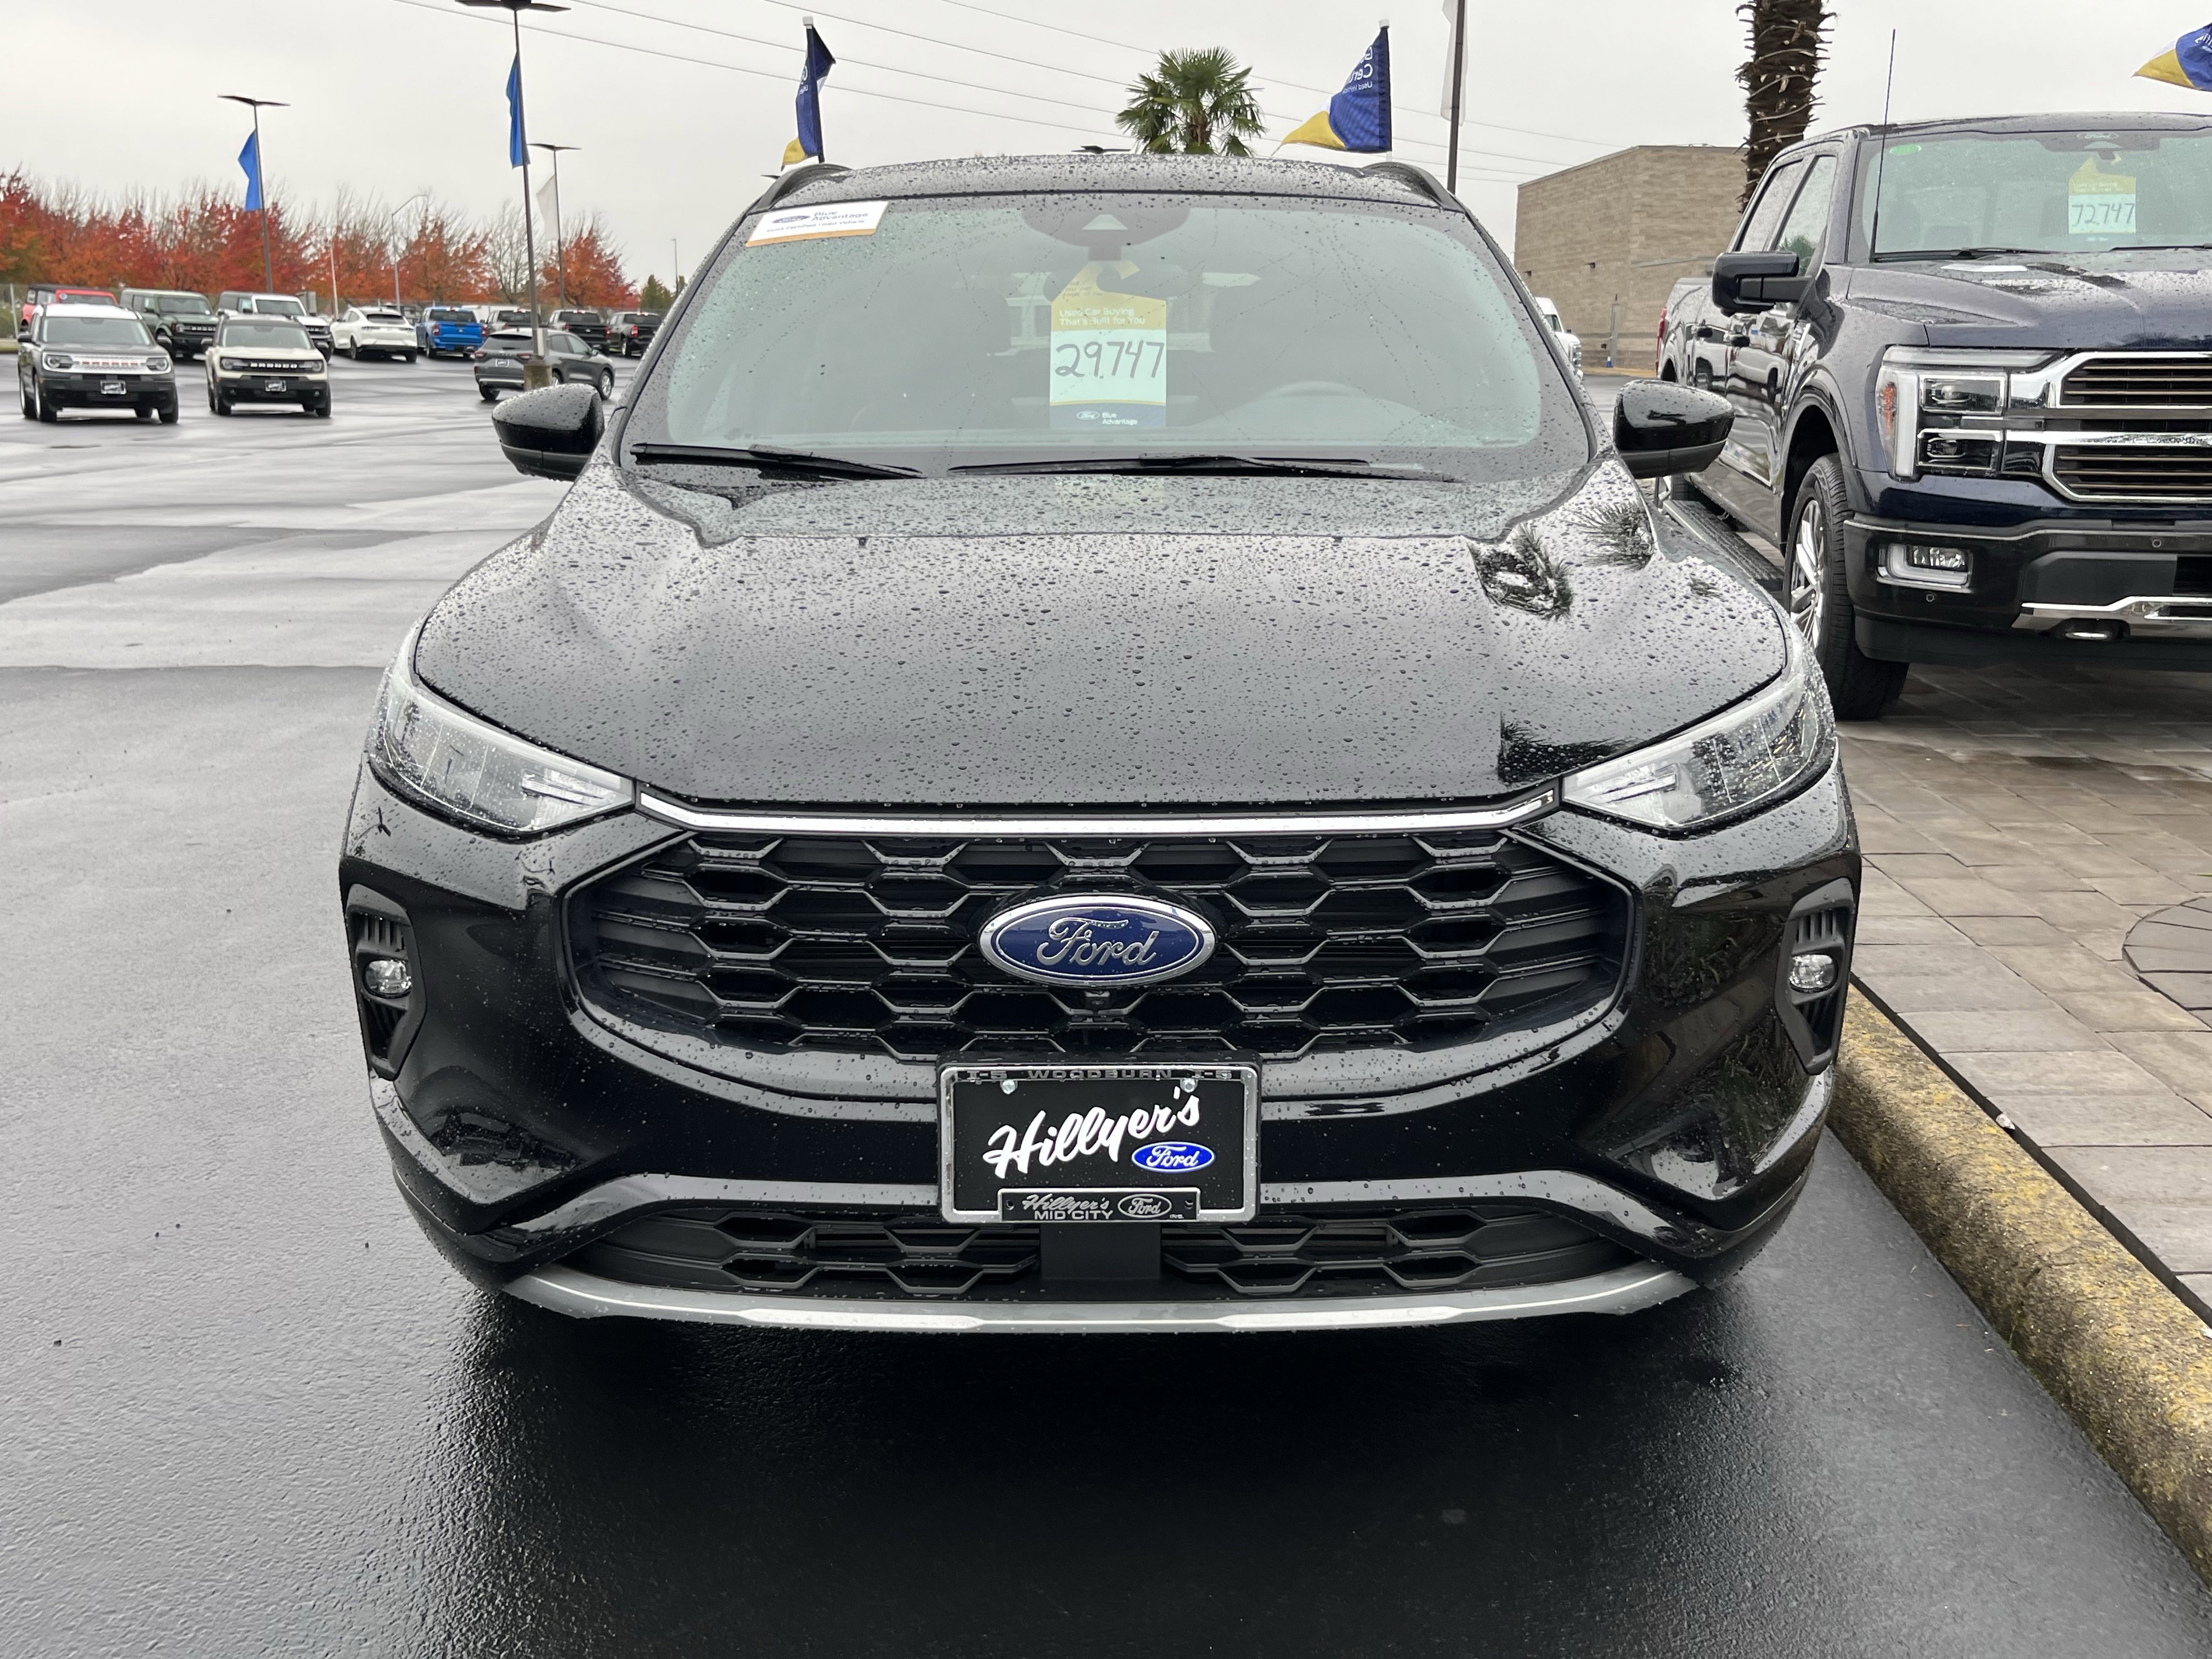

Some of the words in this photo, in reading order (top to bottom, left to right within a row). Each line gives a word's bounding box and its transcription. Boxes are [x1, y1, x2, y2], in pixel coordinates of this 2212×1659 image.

[811, 212, 868, 221] Advantage
[1103, 308, 1135, 318] Buying
[1059, 317, 1088, 325] That's
[1036, 917, 1159, 966] Ford
[966, 1070, 1008, 1080] I-5
[1028, 1069, 1172, 1079] WOODBURN
[983, 1086, 1200, 1178] Hillyer's
[1146, 1145, 1199, 1167] Ford
[1022, 1193, 1110, 1214] Hillyer's
[1034, 1210, 1066, 1220] MID
[1071, 1210, 1114, 1220] CITY
